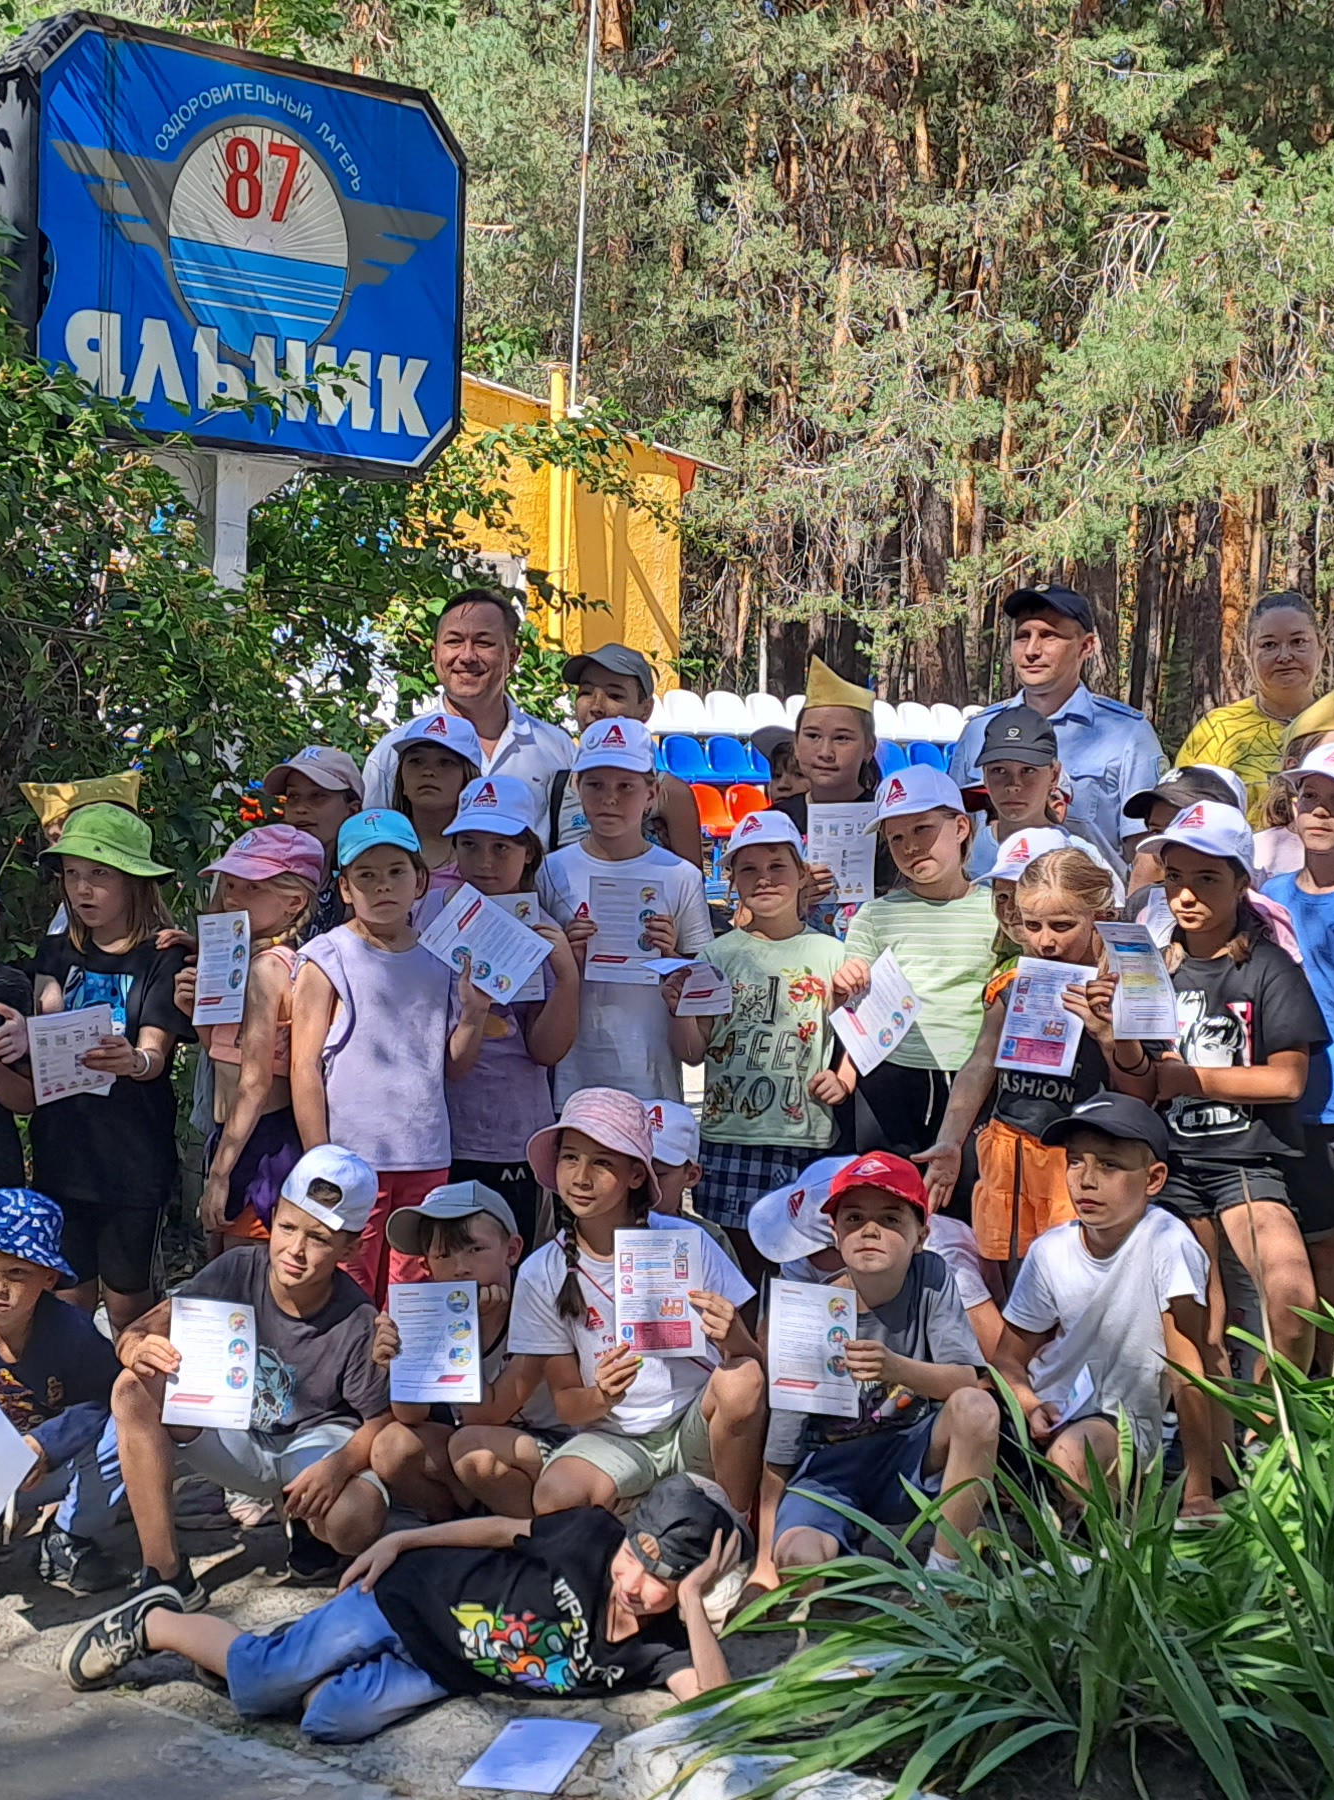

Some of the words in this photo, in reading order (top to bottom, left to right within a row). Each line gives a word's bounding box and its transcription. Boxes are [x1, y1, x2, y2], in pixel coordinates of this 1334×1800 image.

[155, 83, 313, 151] ОЗДОРОВИТЕЛЬНЫЙ
[315, 122, 362, 192] ЛАГЕРЬ
[225, 136, 301, 223] 87
[64, 308, 431, 438] ЯЛЬЧИК
[720, 1074, 804, 1115] YOU
